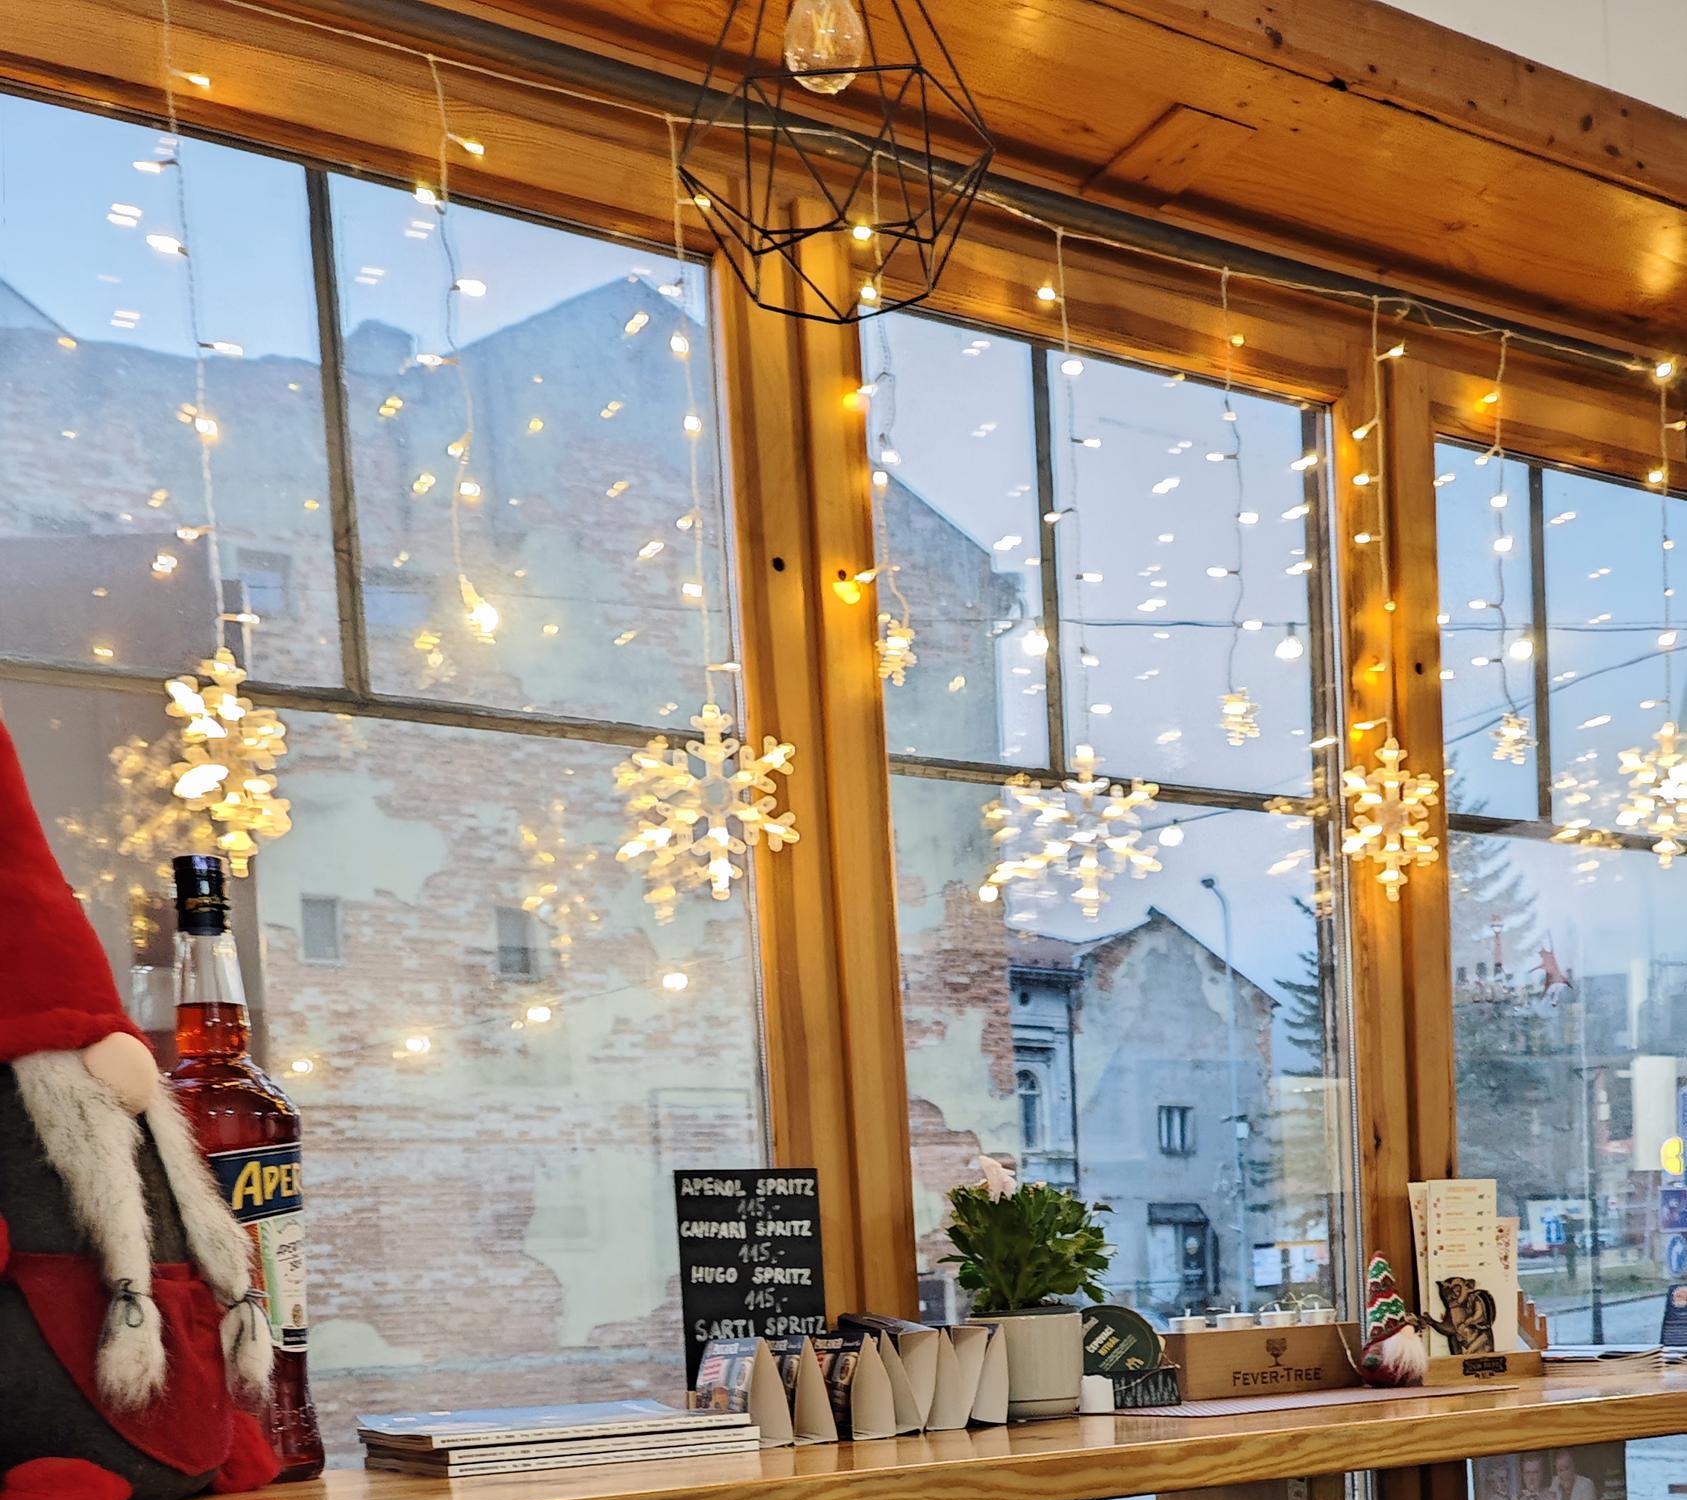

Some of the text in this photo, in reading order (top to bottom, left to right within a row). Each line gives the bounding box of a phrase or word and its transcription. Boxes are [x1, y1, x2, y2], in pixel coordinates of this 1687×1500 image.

[680, 1177, 815, 1197] APEROL SPRITZ
[680, 1220, 813, 1239] CAMPARI SPRITZ
[691, 1265, 812, 1285] HUGO SPRITZ
[695, 1315, 827, 1342] SARTI SPRITZ
[1232, 1368, 1322, 1387] FEVER-TREE
